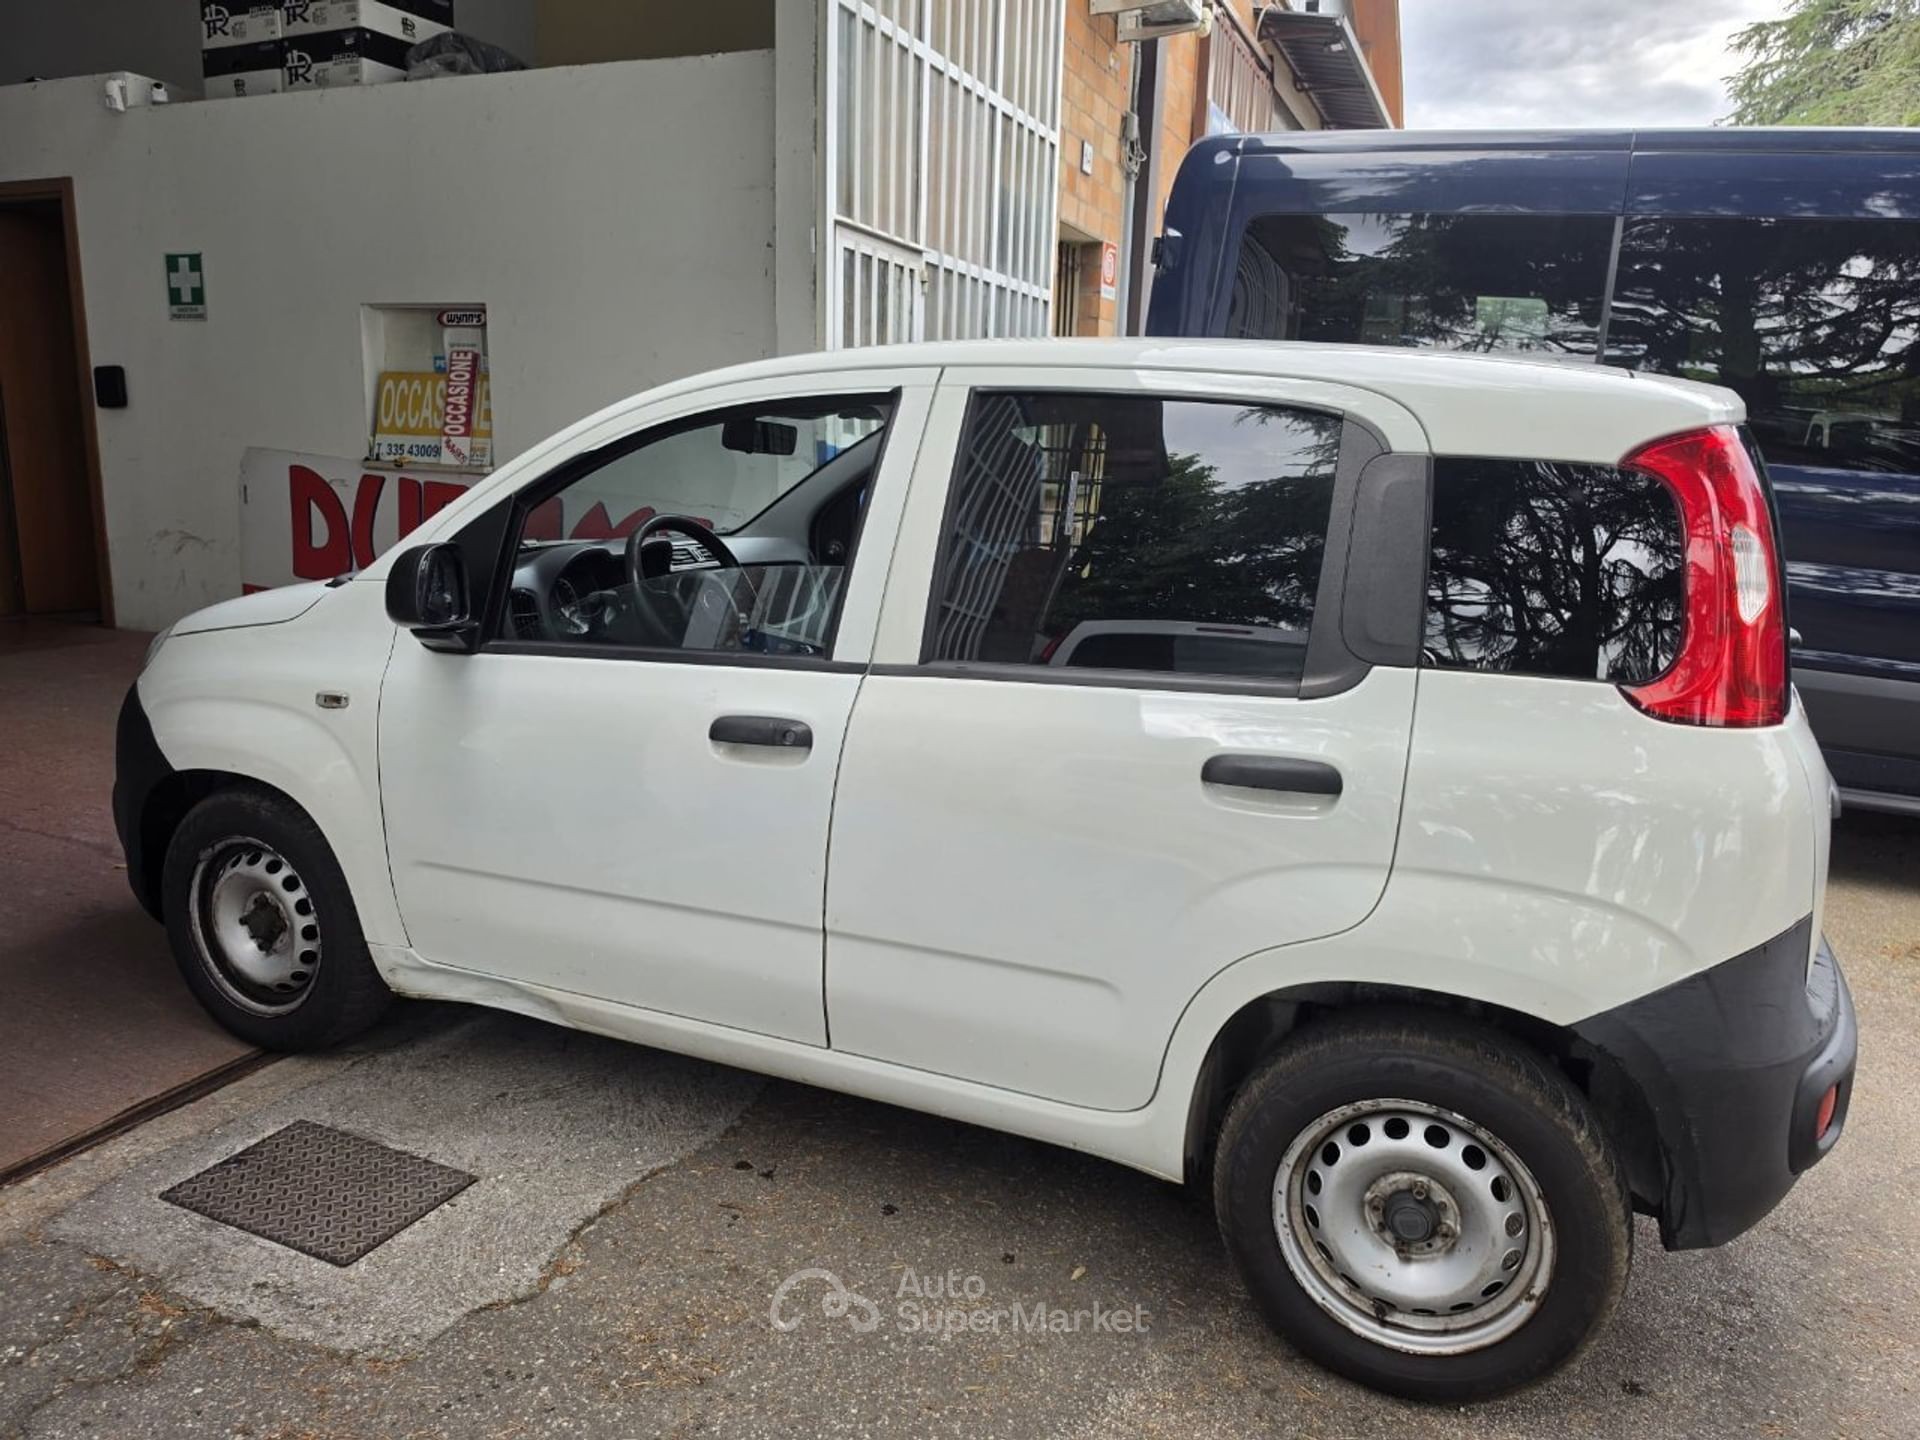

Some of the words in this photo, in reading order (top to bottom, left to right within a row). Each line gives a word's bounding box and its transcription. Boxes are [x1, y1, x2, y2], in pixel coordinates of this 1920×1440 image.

[382, 379, 491, 431] OCCASE
[444, 350, 473, 436] OCCASIONE
[386, 442, 405, 457] 335
[407, 443, 442, 458] 43009
